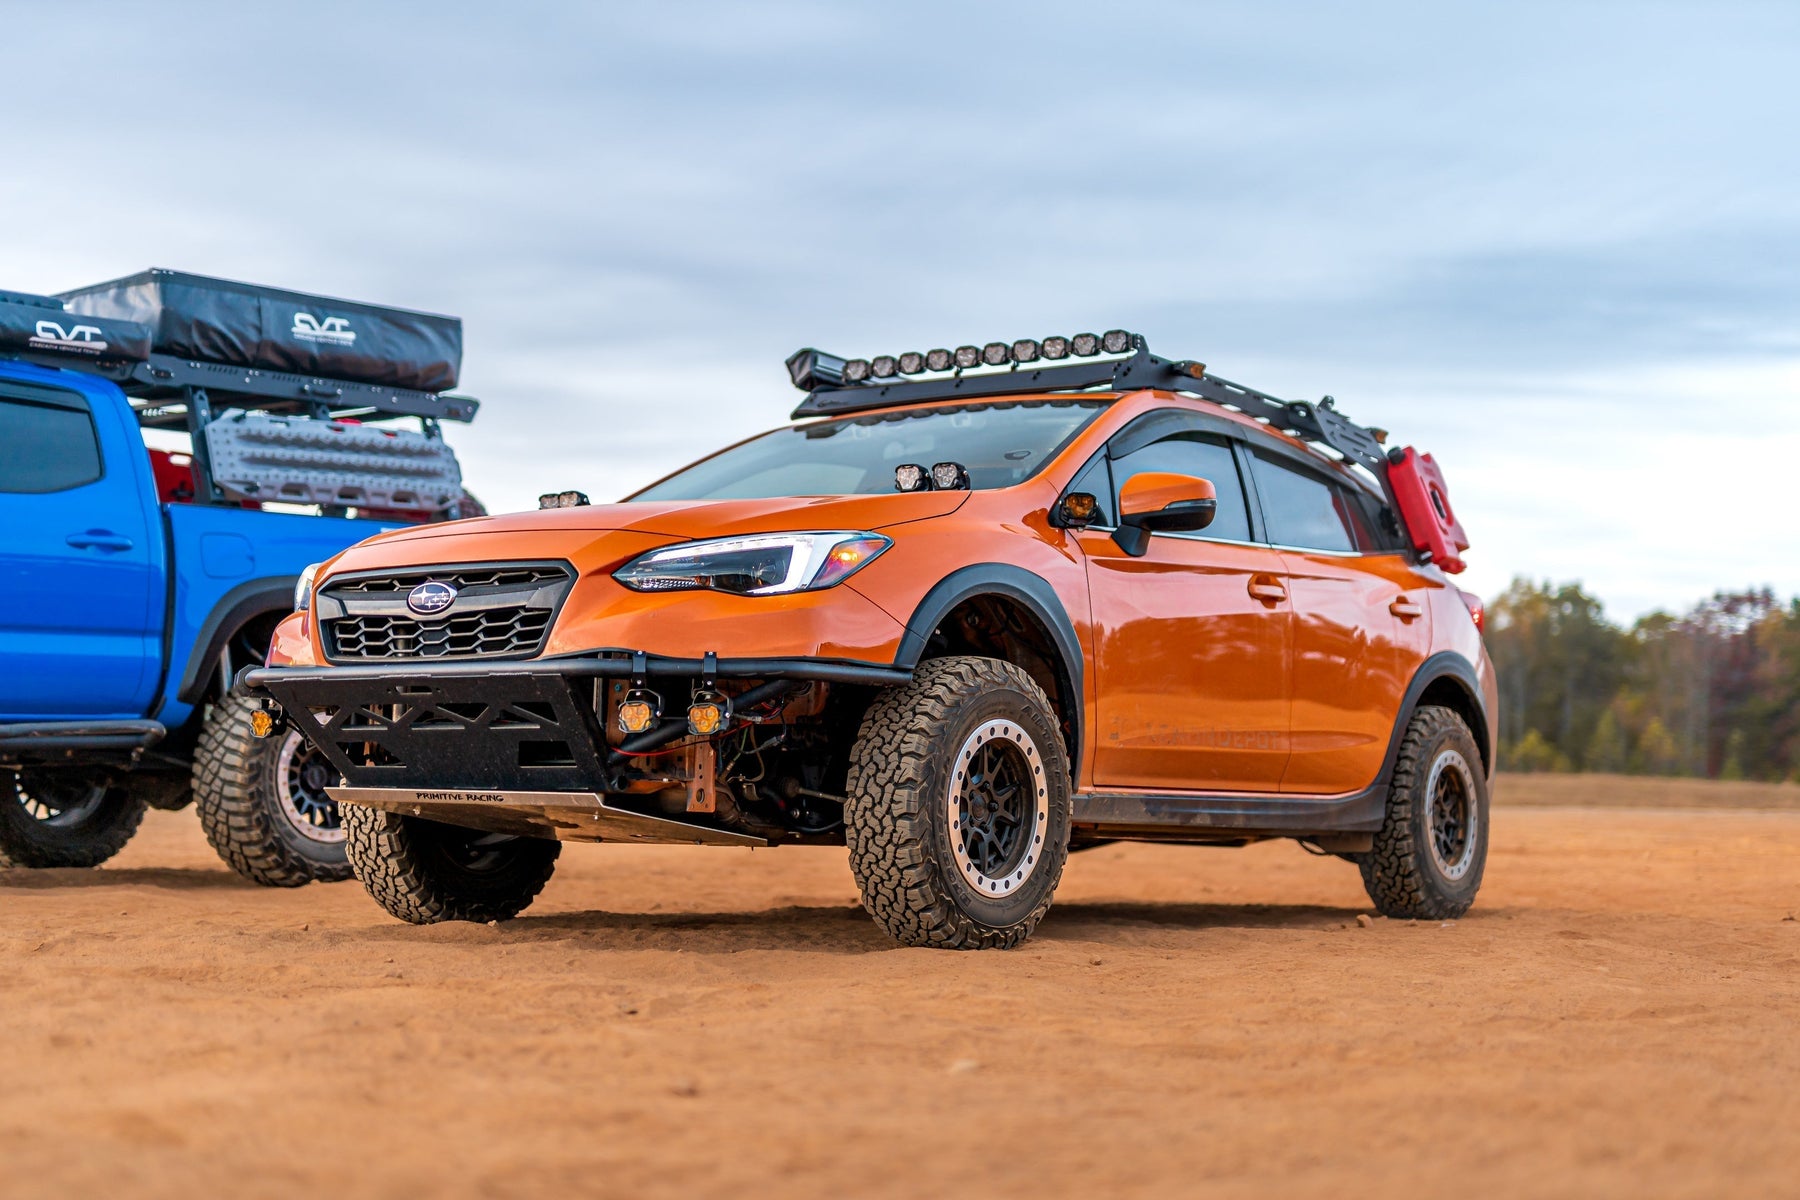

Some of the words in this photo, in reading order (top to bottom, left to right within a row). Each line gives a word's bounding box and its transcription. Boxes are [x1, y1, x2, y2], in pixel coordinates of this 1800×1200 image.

[36, 320, 102, 342] CVT
[294, 312, 350, 332] CVT
[416, 792, 464, 801] PRIMITIVE
[466, 793, 504, 802] RACING
